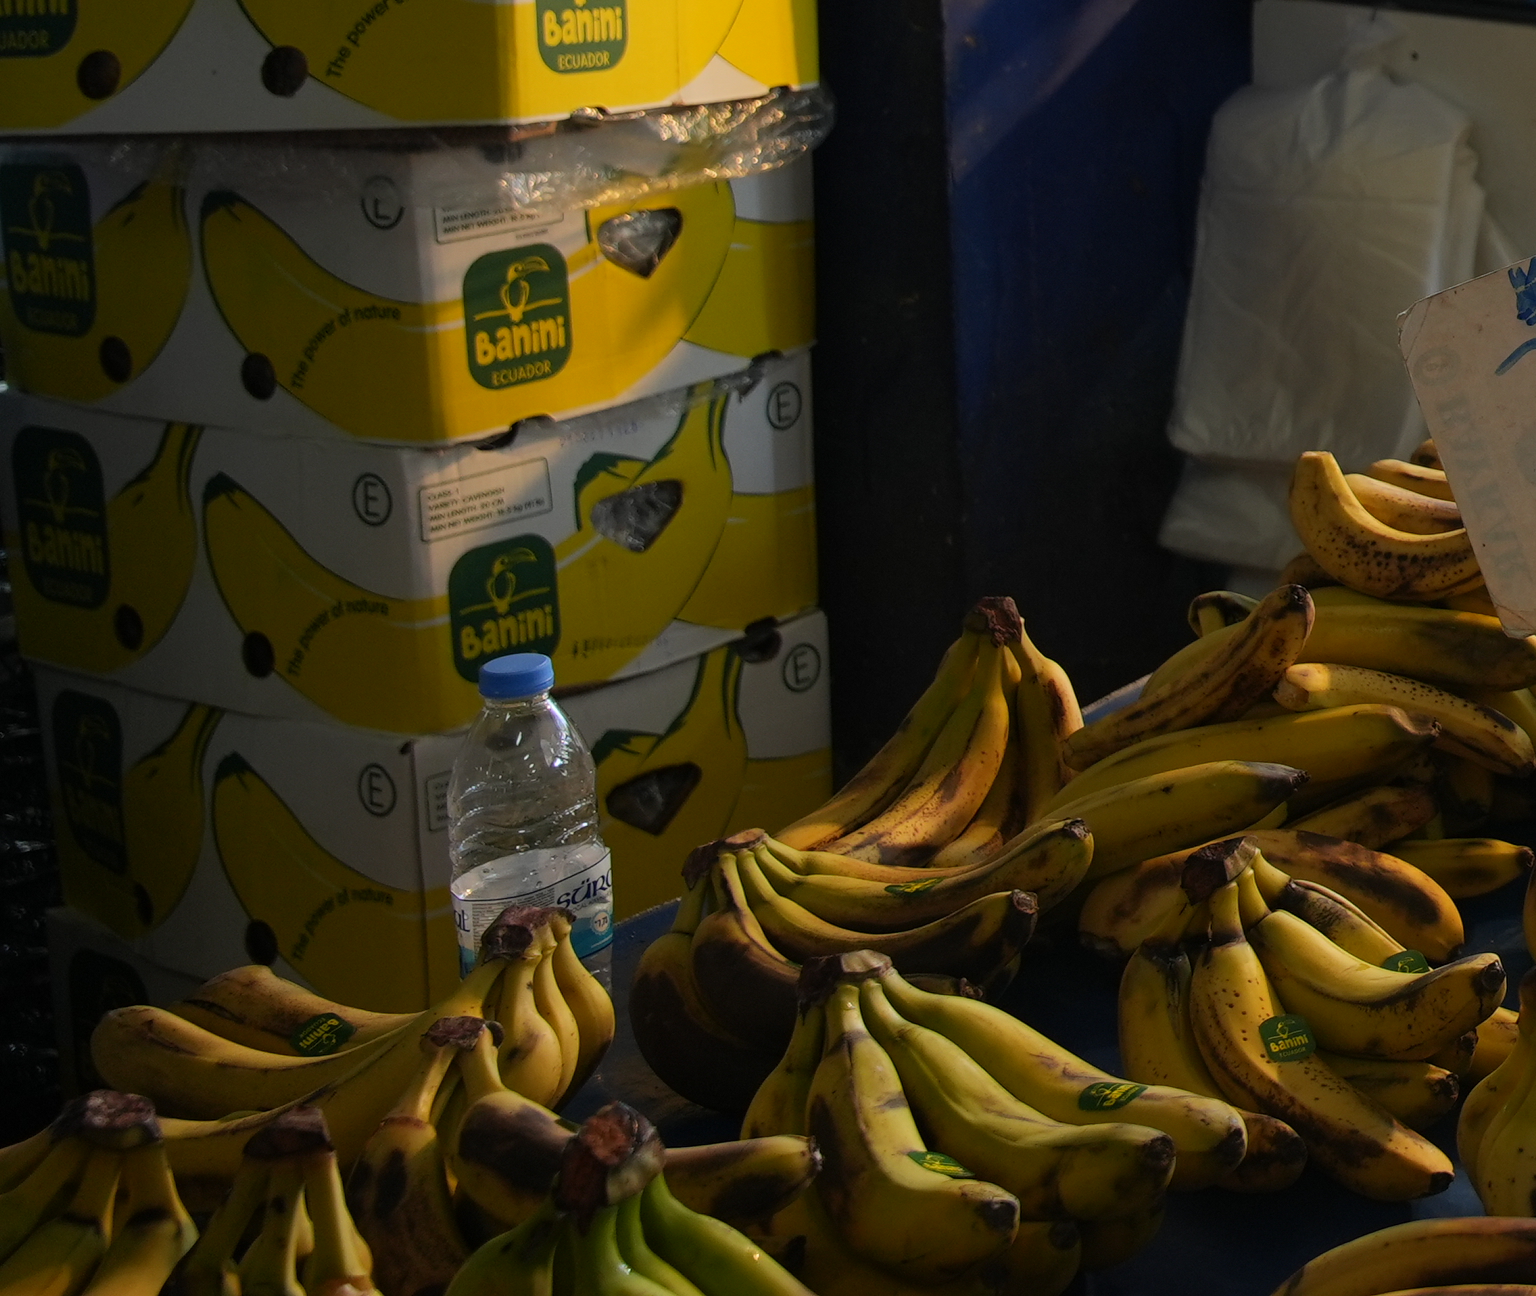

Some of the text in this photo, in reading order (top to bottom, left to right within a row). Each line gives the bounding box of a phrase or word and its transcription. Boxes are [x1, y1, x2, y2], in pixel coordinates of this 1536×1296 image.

[542, 6, 624, 47] Banini
[326, 45, 352, 79] The
[557, 50, 611, 71] ECUADOR
[474, 315, 567, 367] Banini
[490, 359, 552, 387] ECUADOR
[459, 603, 554, 660] Banini
[1269, 1033, 1310, 1054] Banini
